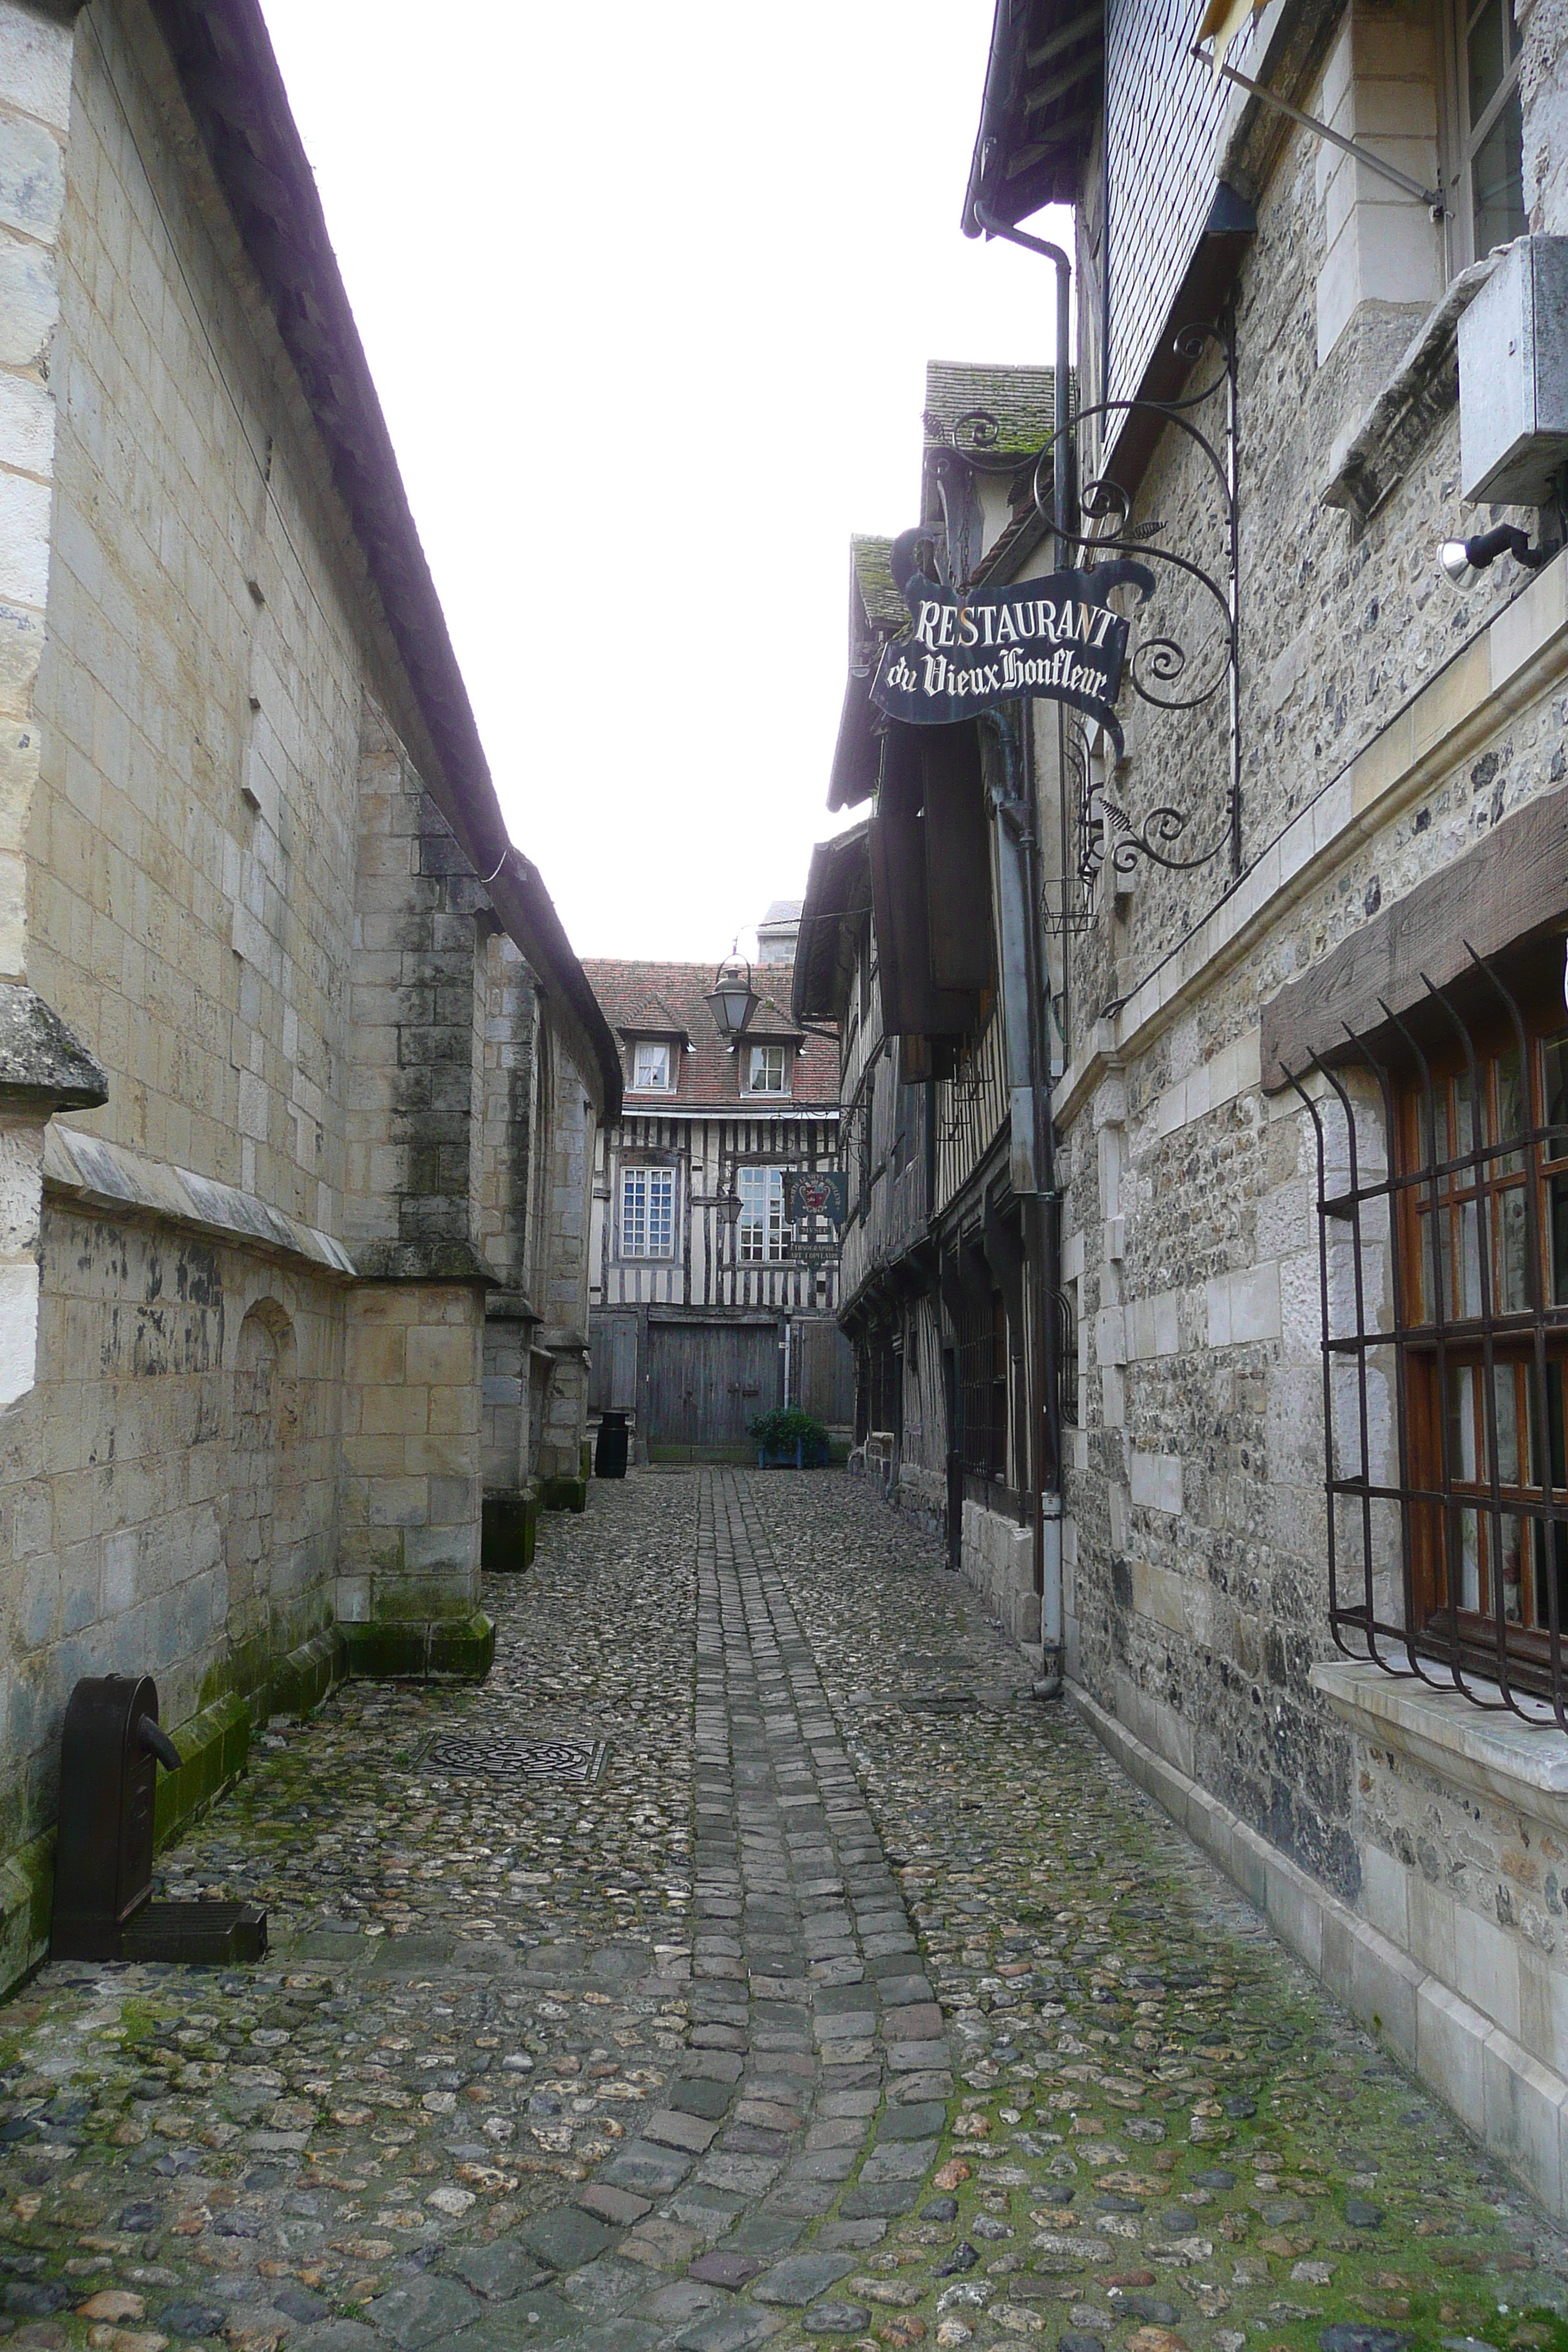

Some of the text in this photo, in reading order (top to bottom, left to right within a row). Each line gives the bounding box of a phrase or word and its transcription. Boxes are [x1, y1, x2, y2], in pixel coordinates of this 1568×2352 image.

[914, 599, 1118, 652] RESTAURANT
[886, 647, 1107, 700] du Vieux Honfleur
